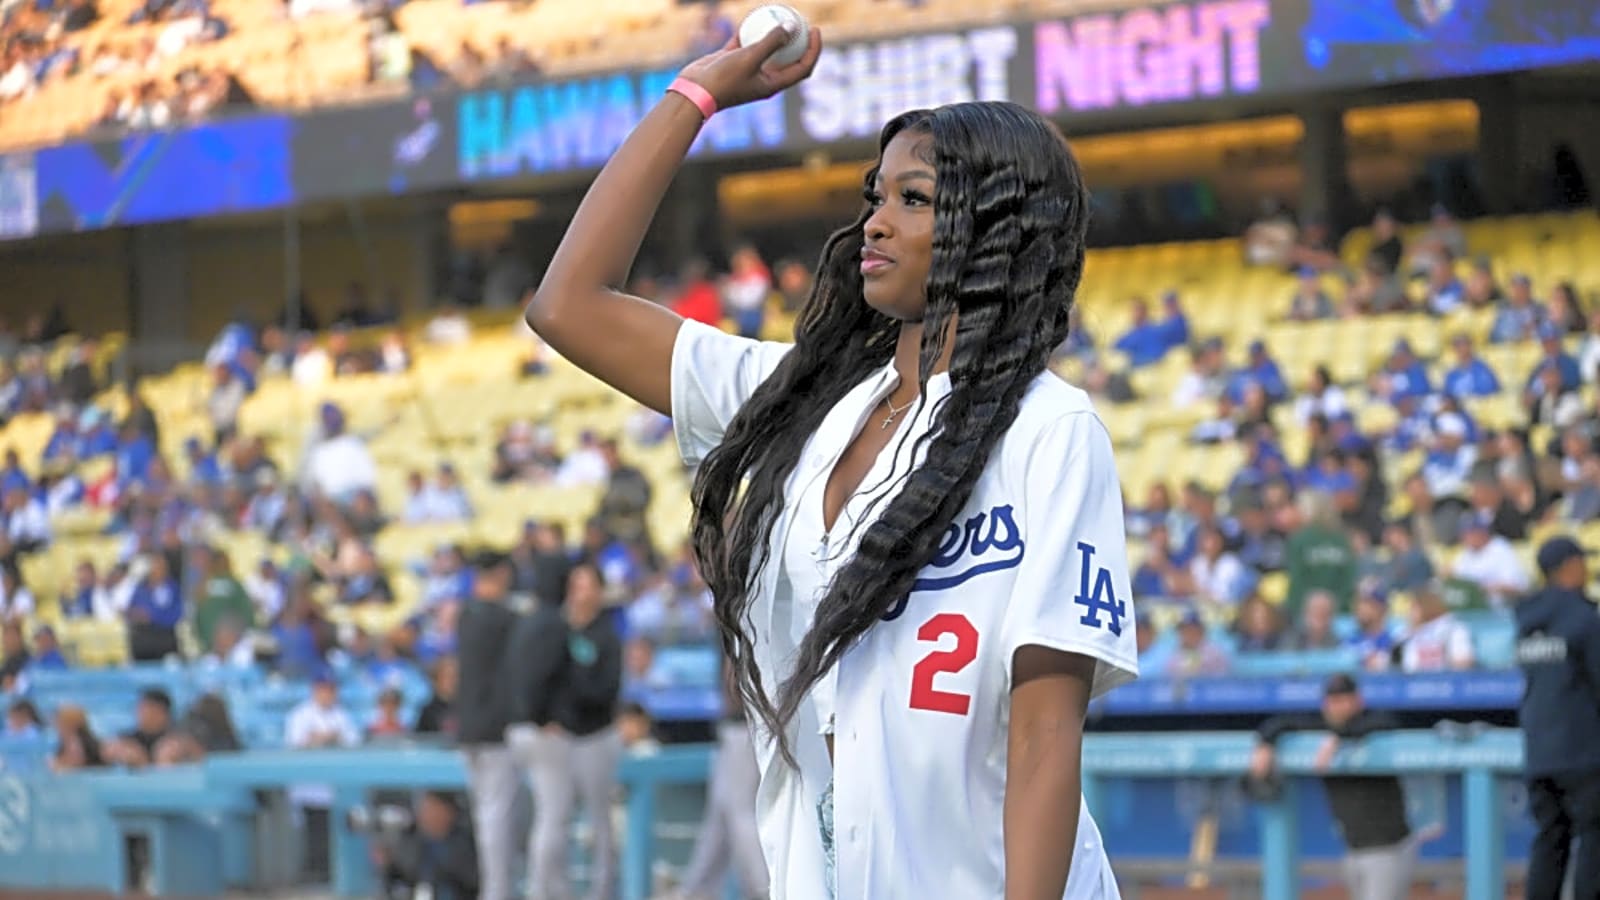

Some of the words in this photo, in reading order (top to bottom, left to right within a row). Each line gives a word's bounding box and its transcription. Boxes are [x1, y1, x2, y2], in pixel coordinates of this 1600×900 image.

[458, 68, 786, 178] HAWAN
[802, 27, 1017, 140] SHIRT
[1034, 0, 1270, 112] NIGHT
[1074, 541, 1125, 637] LA
[909, 613, 979, 716] 2
